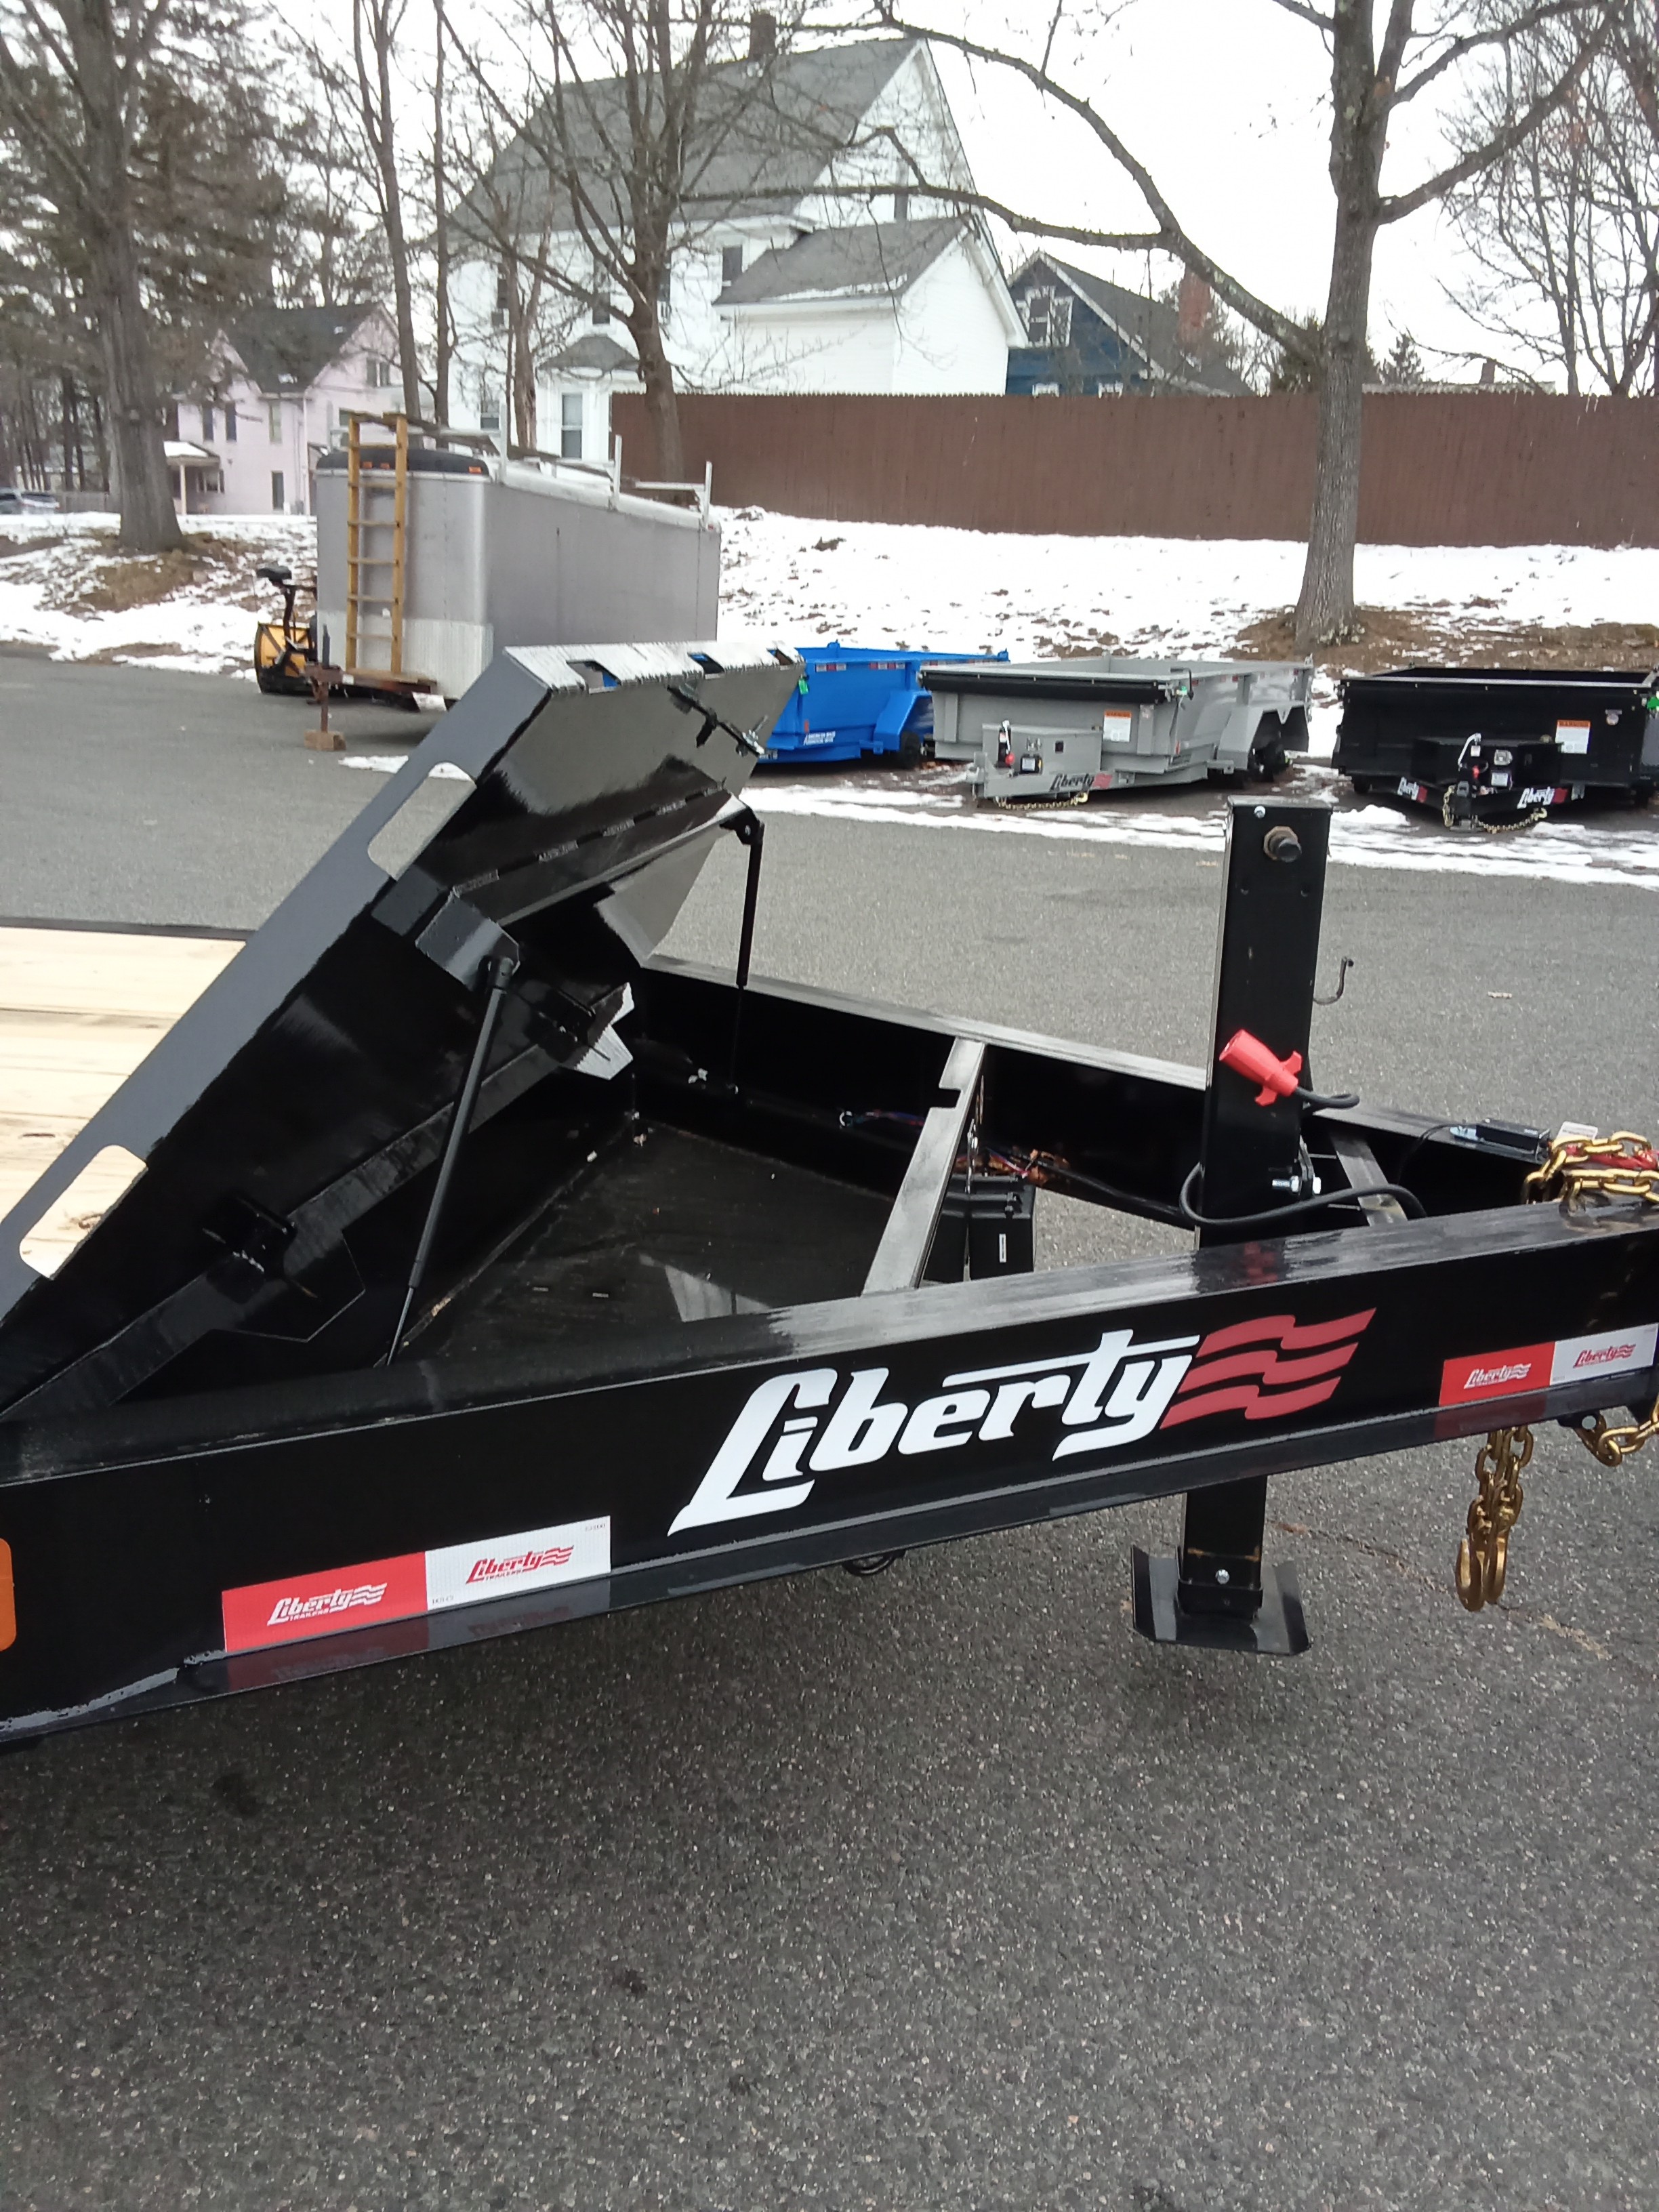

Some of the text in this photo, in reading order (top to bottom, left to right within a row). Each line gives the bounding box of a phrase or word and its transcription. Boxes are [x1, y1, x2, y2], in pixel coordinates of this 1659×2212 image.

[1050, 773, 1094, 792] Liberty
[1517, 786, 1555, 809] Liberty
[1573, 1347, 1619, 1368] Liberty
[1464, 1365, 1513, 1389] Liberty
[668, 1329, 1200, 1536] Liberty
[466, 1551, 544, 1584] Liberty
[267, 1589, 354, 1626] Liberty
